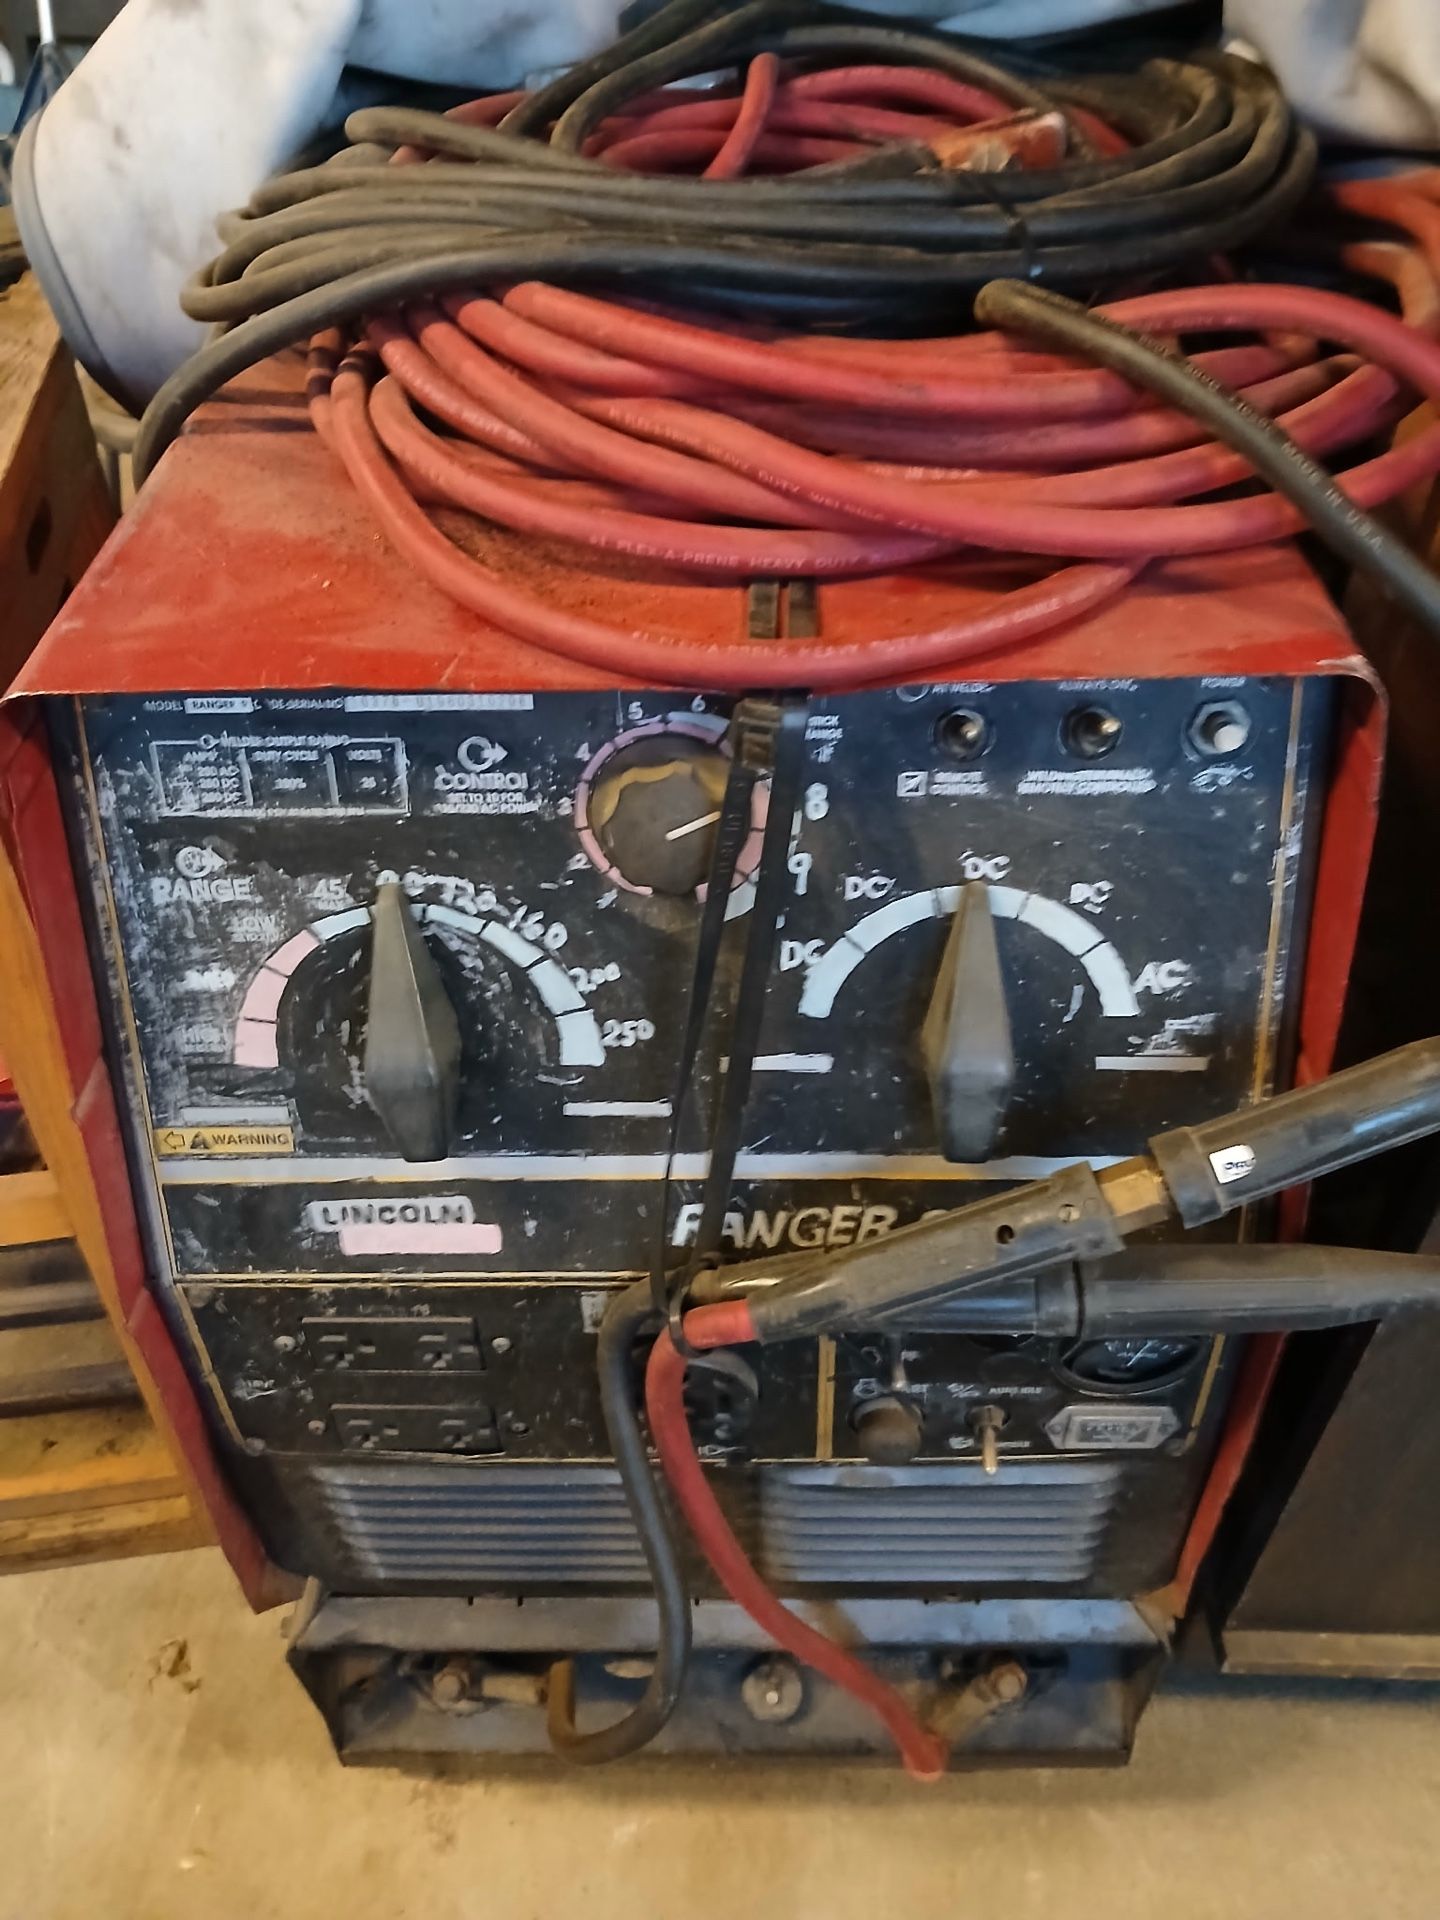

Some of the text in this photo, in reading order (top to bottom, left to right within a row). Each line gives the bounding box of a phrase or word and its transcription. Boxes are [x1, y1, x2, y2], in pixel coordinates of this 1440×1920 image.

[757, 468, 801, 495] DUTY
[1281, 440, 1322, 487] MADE
[1325, 487, 1344, 508] IN
[750, 556, 806, 570] HEAVY
[814, 554, 861, 570] DUTY
[143, 700, 184, 711] MODEL
[627, 702, 645, 720] 5
[691, 695, 706, 713] 6
[575, 742, 592, 762] 4
[804, 782, 829, 821] 8
[787, 852, 813, 896] 9
[962, 854, 1011, 881] DC
[150, 875, 254, 904] RANGE
[312, 877, 344, 898] 45
[844, 874, 894, 901] DC
[780, 937, 826, 971] DC
[1133, 959, 1191, 995] AC
[601, 1018, 656, 1048] 250
[211, 1132, 291, 1147] WARNING
[320, 1203, 466, 1225] LINCOLN
